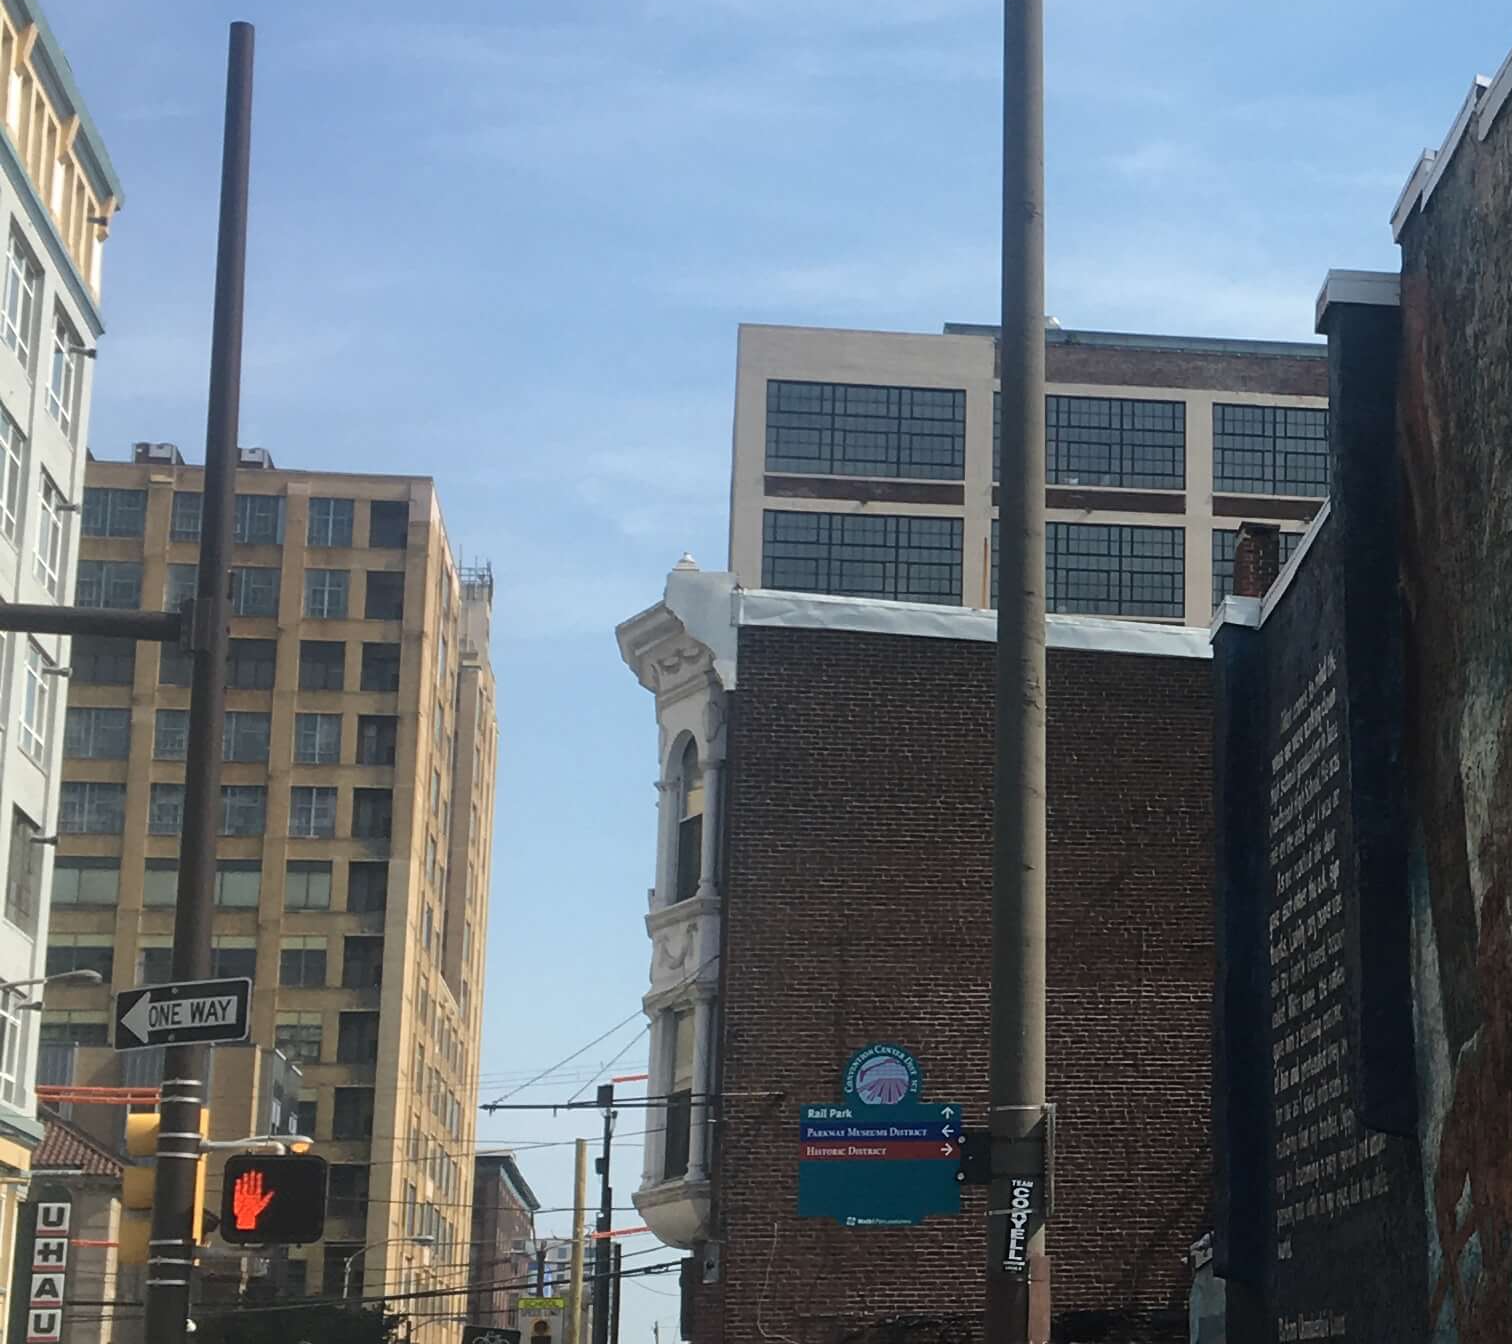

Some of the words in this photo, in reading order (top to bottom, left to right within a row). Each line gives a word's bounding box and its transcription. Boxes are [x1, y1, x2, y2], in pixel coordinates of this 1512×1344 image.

[148, 1003, 182, 1028] ONE
[190, 999, 232, 1024] WAY
[874, 1045, 905, 1060] CENTER
[807, 1109, 828, 1119] Rail
[829, 1109, 853, 1119] Park
[889, 1127, 928, 1137] DISTRICT
[806, 1146, 846, 1156] HISTORIC
[848, 1146, 887, 1156] DISTRICT
